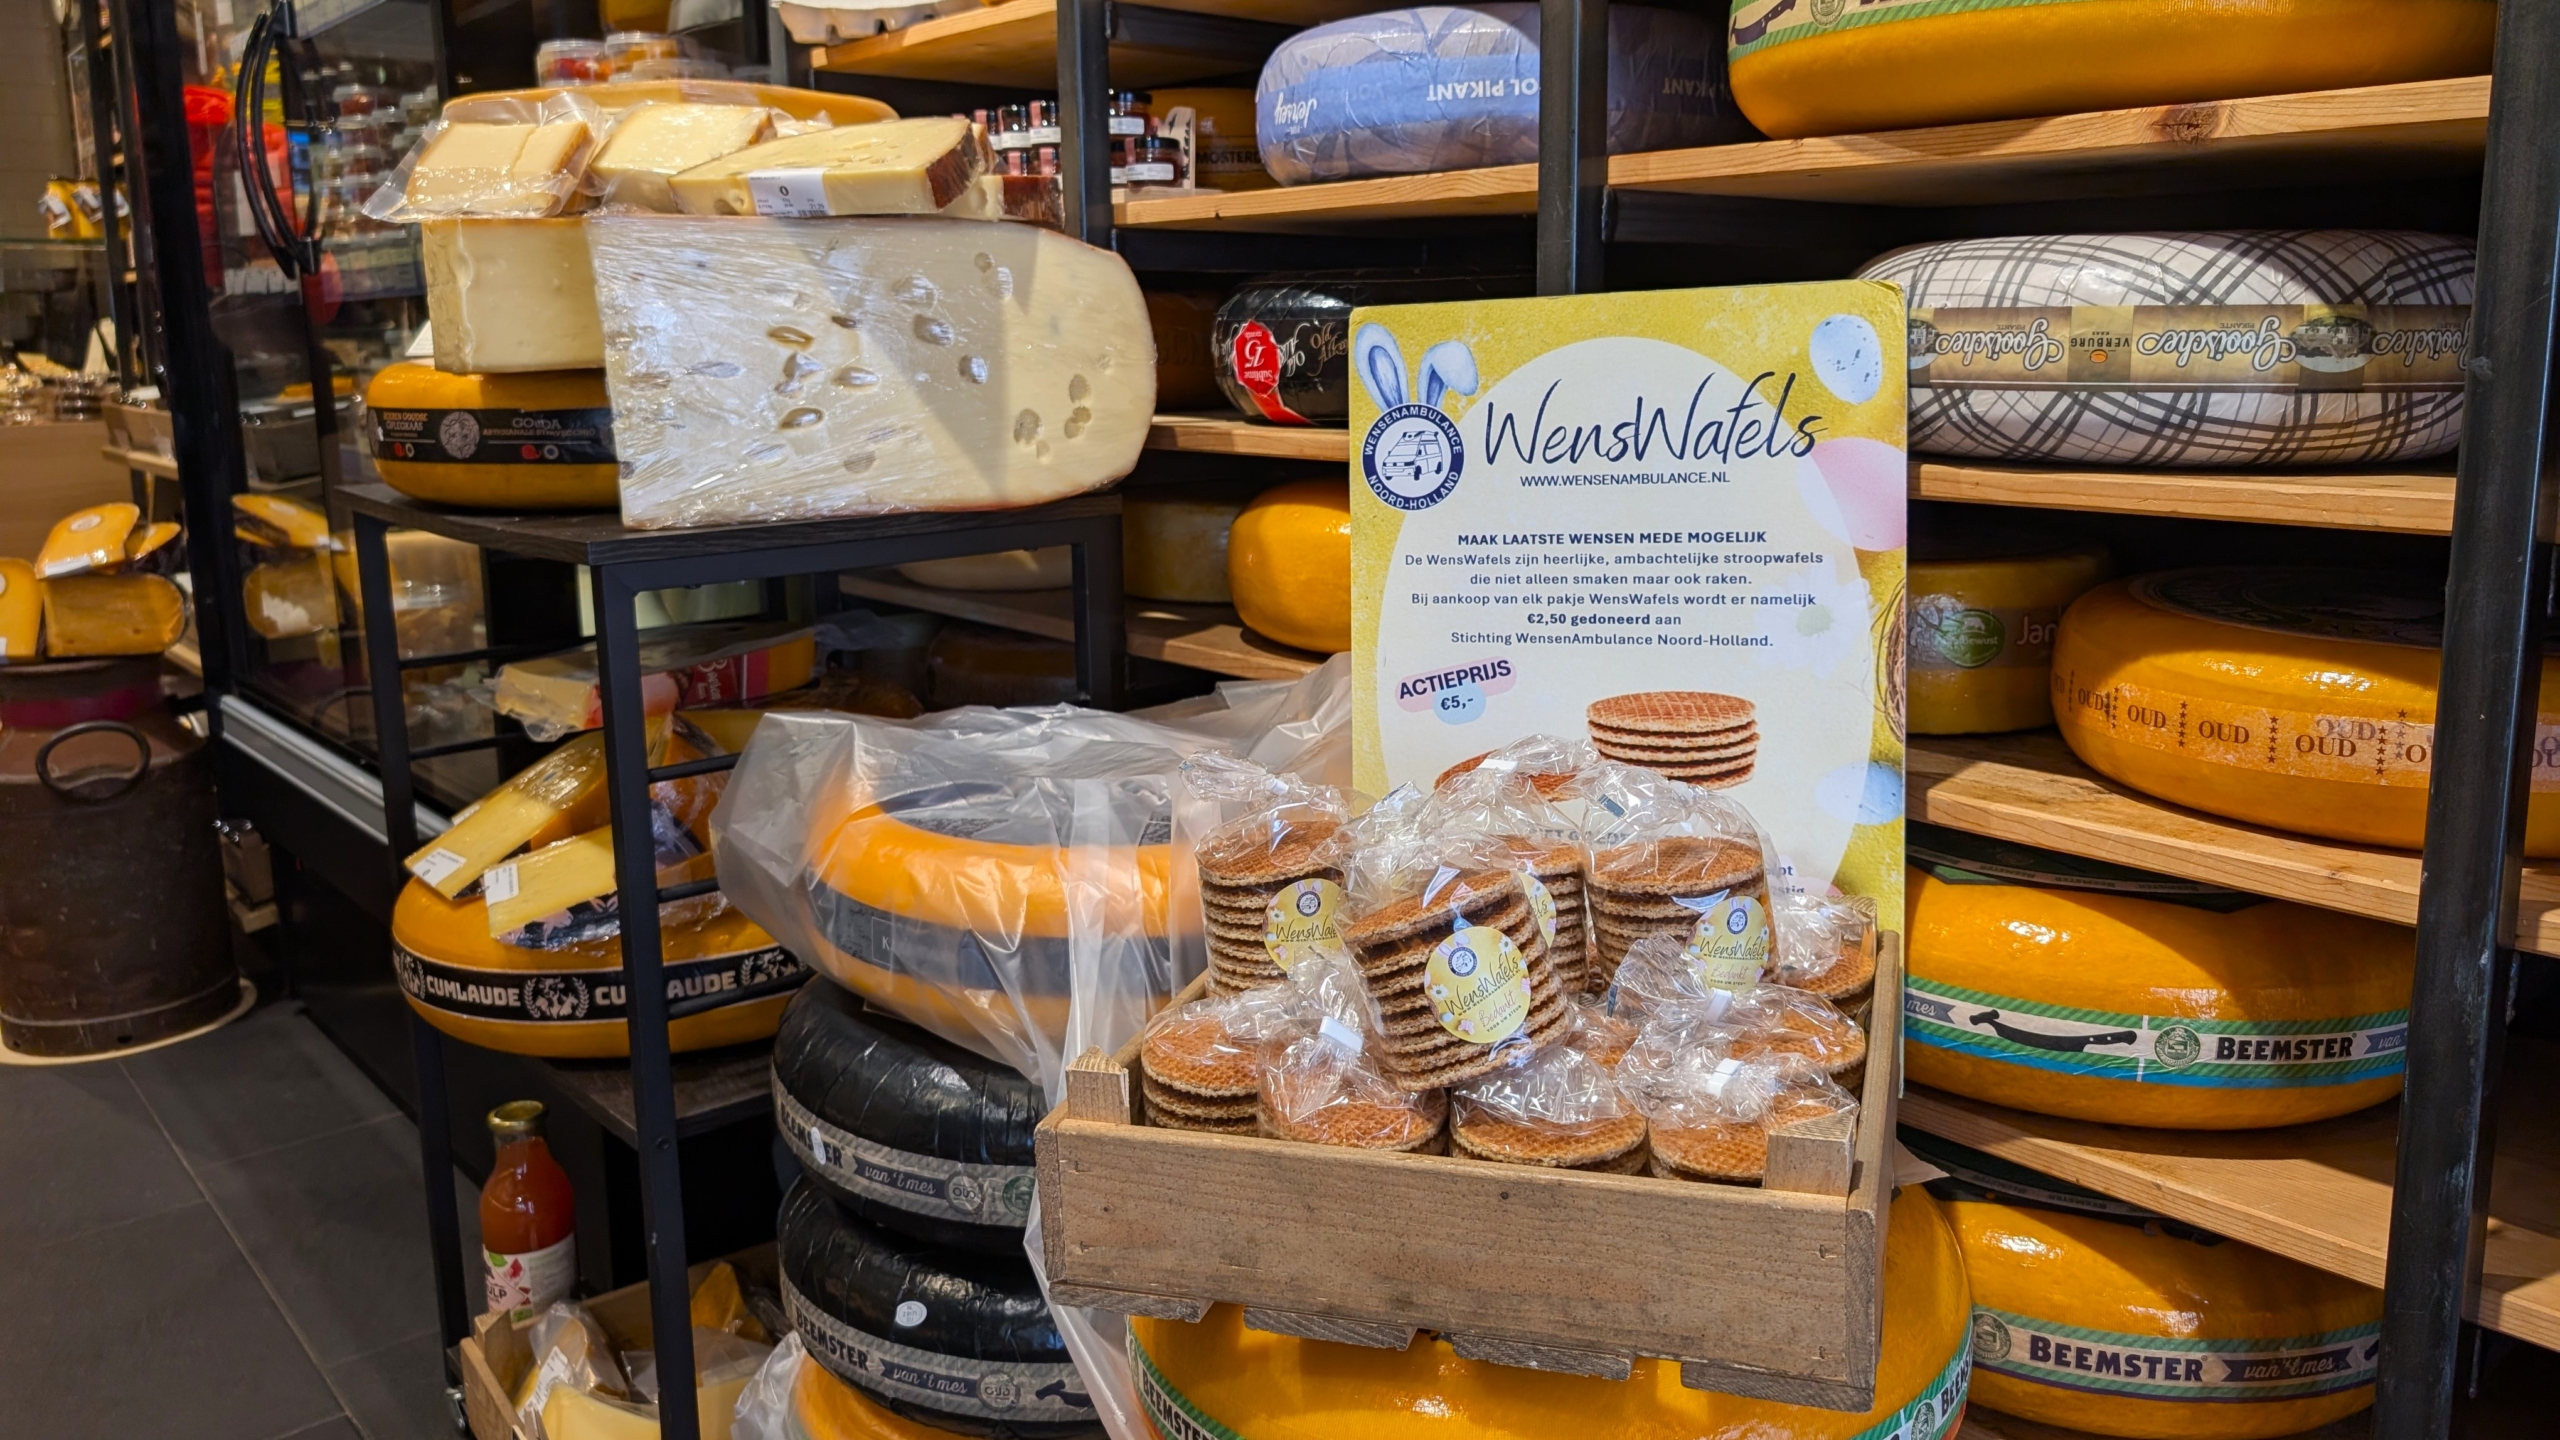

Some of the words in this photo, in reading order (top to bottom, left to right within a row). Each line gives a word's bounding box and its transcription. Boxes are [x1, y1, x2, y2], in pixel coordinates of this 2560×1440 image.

[1426, 79, 1505, 102] PIKANT
[1509, 78, 1540, 97] OL
[1274, 92, 1318, 129] Jersey
[1935, 317, 2065, 371] Gooische
[2070, 336, 2130, 348] VERBURG
[2137, 316, 2297, 371] Gooische
[1364, 405, 1463, 456] WENSENAMBULANCE
[1484, 371, 1829, 465] WensWafels
[1367, 471, 1460, 510] NOORD-HOLLAND
[1519, 471, 1731, 487] WWW.WENSENAMBULANCE.NL
[1458, 534, 1499, 546] MAAK
[1502, 533, 1565, 545] LAATSTE
[1569, 533, 1635, 544] WENSEN
[1639, 532, 1683, 544] MEDE
[1687, 531, 1767, 543] MOGELIJK
[1405, 554, 1423, 566] De
[1427, 554, 1511, 566] WensWafels
[1515, 554, 1539, 567] zijn
[1543, 553, 1610, 567] heerlijke,
[1614, 553, 1719, 566] ambachtelijke
[1723, 552, 1824, 566] stroopwafels
[1470, 573, 1491, 585] die
[1495, 573, 1521, 585] niet
[1525, 573, 1569, 585] alleen
[1572, 573, 1628, 585] smaken
[1633, 574, 1670, 584] maar
[1674, 573, 1701, 585] ook
[1705, 573, 1752, 585] raken.
[1411, 593, 1429, 607] Bij
[1432, 593, 1490, 607] aankoop
[1494, 595, 1518, 604] van
[1522, 593, 1543, 605] elk
[1547, 593, 1585, 607] pakje
[1589, 593, 1679, 605] WensWafels
[1684, 593, 1726, 605] wordt
[1731, 595, 1746, 605] er
[1750, 593, 1816, 608] namelijk
[1527, 613, 1567, 626] €2,50
[1571, 613, 1650, 627] gedoneerd
[1655, 615, 1682, 625] aan
[1451, 632, 1512, 646] Stichting
[1515, 632, 1653, 645] WensenAmbulance
[1657, 634, 1774, 647] Noord-Holland.
[1400, 659, 1512, 700] ACTIEPRIJS
[1440, 695, 1474, 711] €5,-
[2078, 688, 2105, 712] OUD
[2127, 704, 2167, 729] OUD
[2198, 720, 2250, 744] OUD
[2315, 718, 2376, 741] OUD
[2294, 733, 2358, 758] OUD
[1699, 935, 1767, 960] WensWafels
[1444, 951, 1519, 1016] WensWafels
[1710, 963, 1750, 980] Bedankt
[425, 974, 522, 1008] CUMLAUDE
[1478, 989, 1517, 1028] Bedankt
[1906, 999, 1938, 1016] mes
[2216, 1036, 2354, 1061] BEEMSTER
[864, 1165, 890, 1184] van
[906, 1180, 936, 1196] mes
[798, 1313, 870, 1373] BEEMSTER
[2029, 1334, 2204, 1383] BEEMSTER
[2243, 1363, 2280, 1379] van
[2299, 1355, 2336, 1376] mes
[893, 1366, 920, 1384] van
[937, 1376, 969, 1395] mes
